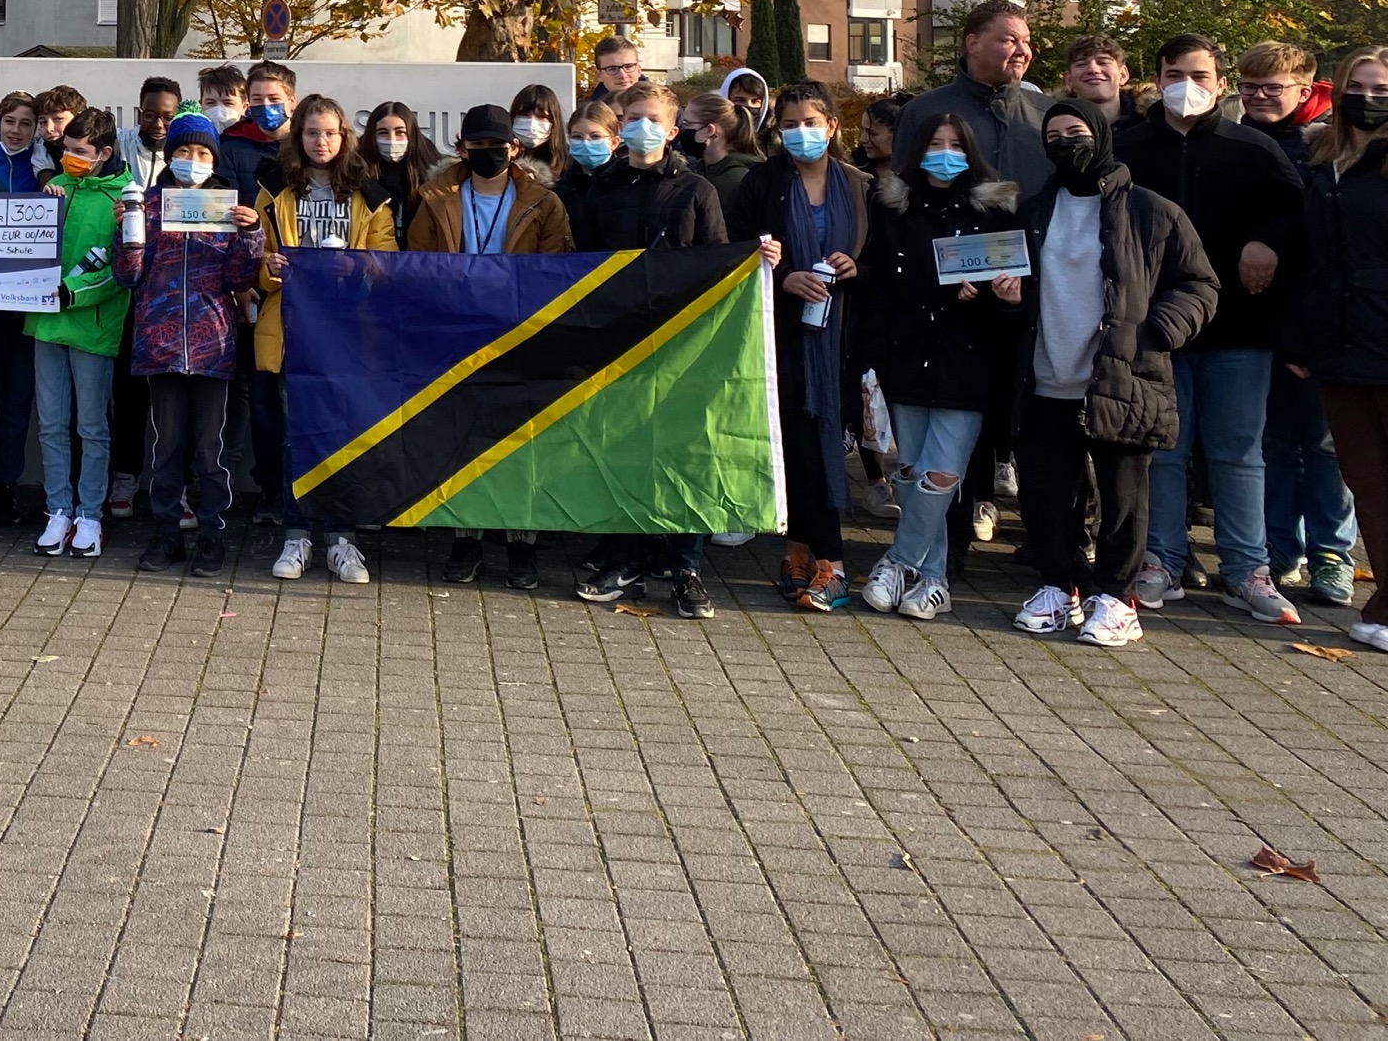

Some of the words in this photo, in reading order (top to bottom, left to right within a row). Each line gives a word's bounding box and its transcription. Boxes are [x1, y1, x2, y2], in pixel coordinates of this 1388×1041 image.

[182, 211, 199, 219] 150
[202, 211, 208, 219] €
[1, 231, 21, 241] EUR
[25, 228, 55, 243] 00/100
[960, 257, 981, 267] 100
[985, 256, 992, 266] €
[1, 293, 39, 303] Volksbank
